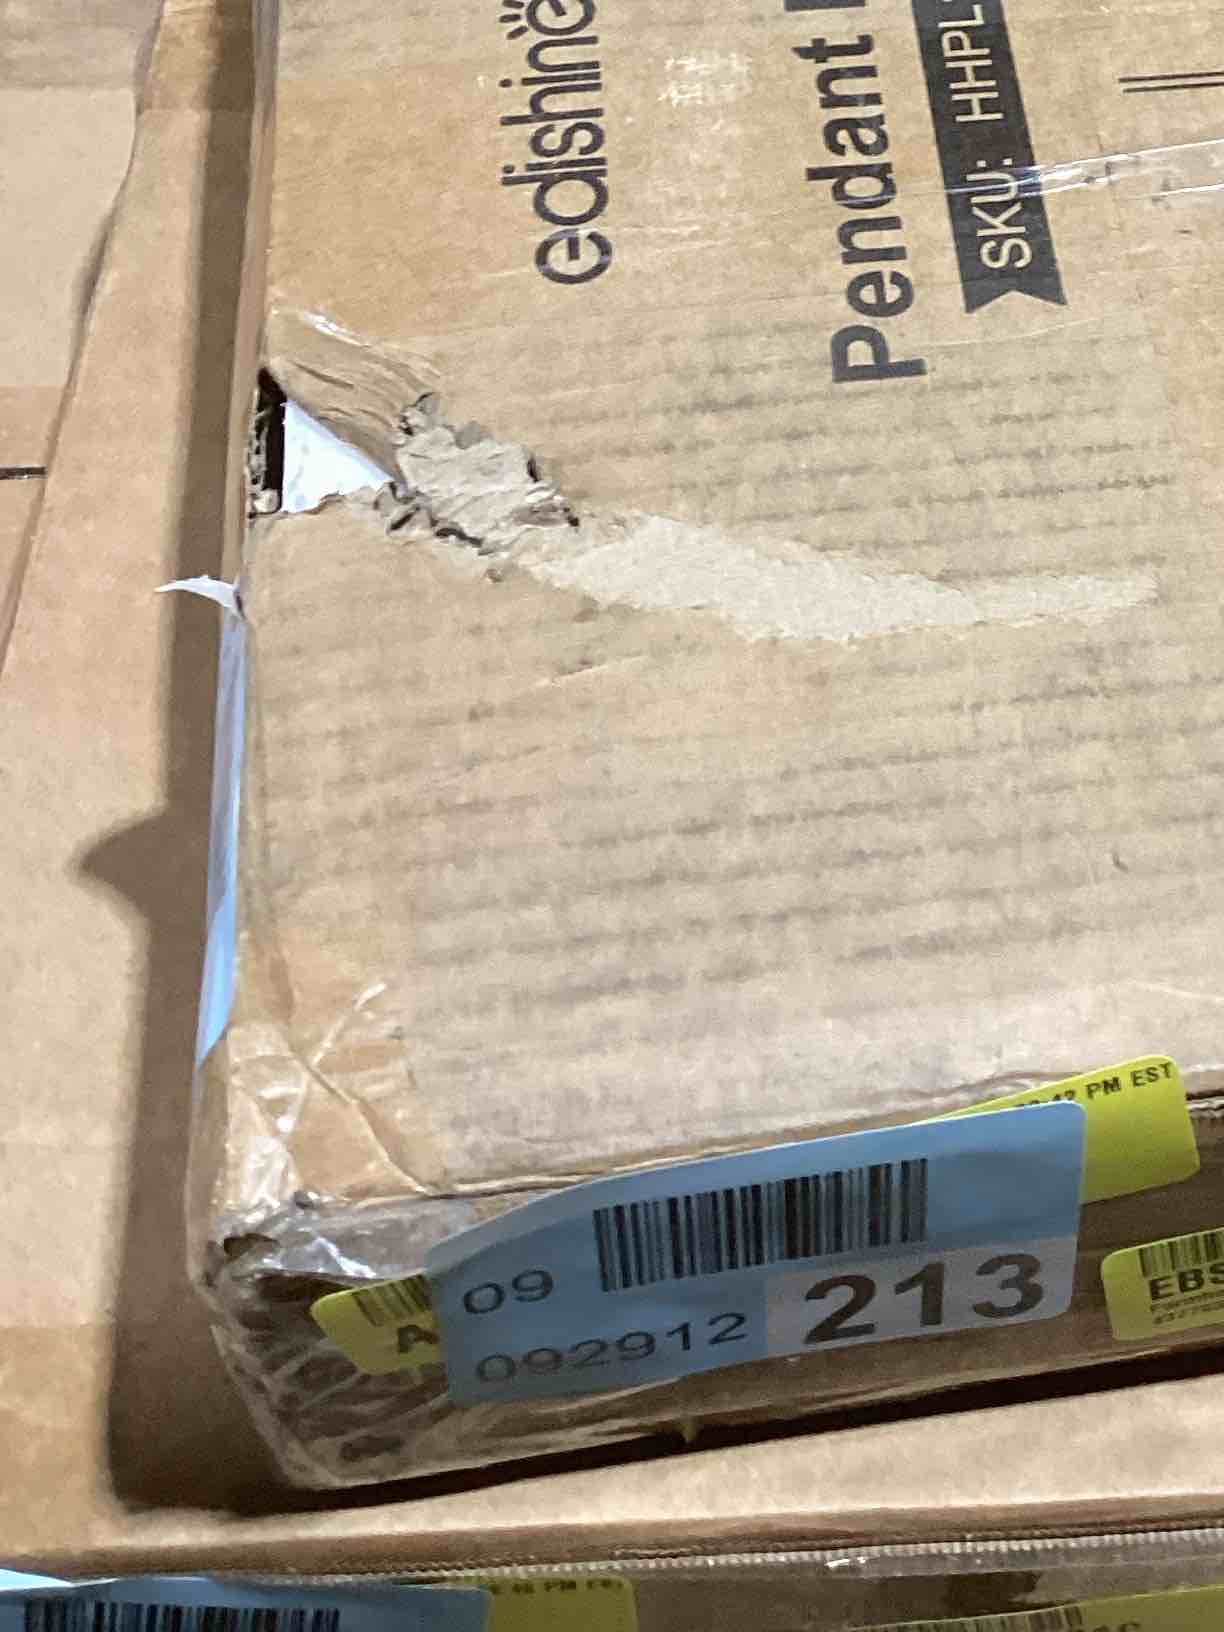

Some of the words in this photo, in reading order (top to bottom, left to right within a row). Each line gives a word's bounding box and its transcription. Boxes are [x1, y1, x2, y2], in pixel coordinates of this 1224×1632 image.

[792, 32, 928, 384] Pendant
[965, 157, 1034, 270] SKU:
[1085, 1076, 1122, 1100] PM
[1130, 1061, 1173, 1087] EST
[462, 1268, 554, 1315] 09
[802, 1253, 1044, 1345] 213
[475, 1311, 747, 1384] 092912
